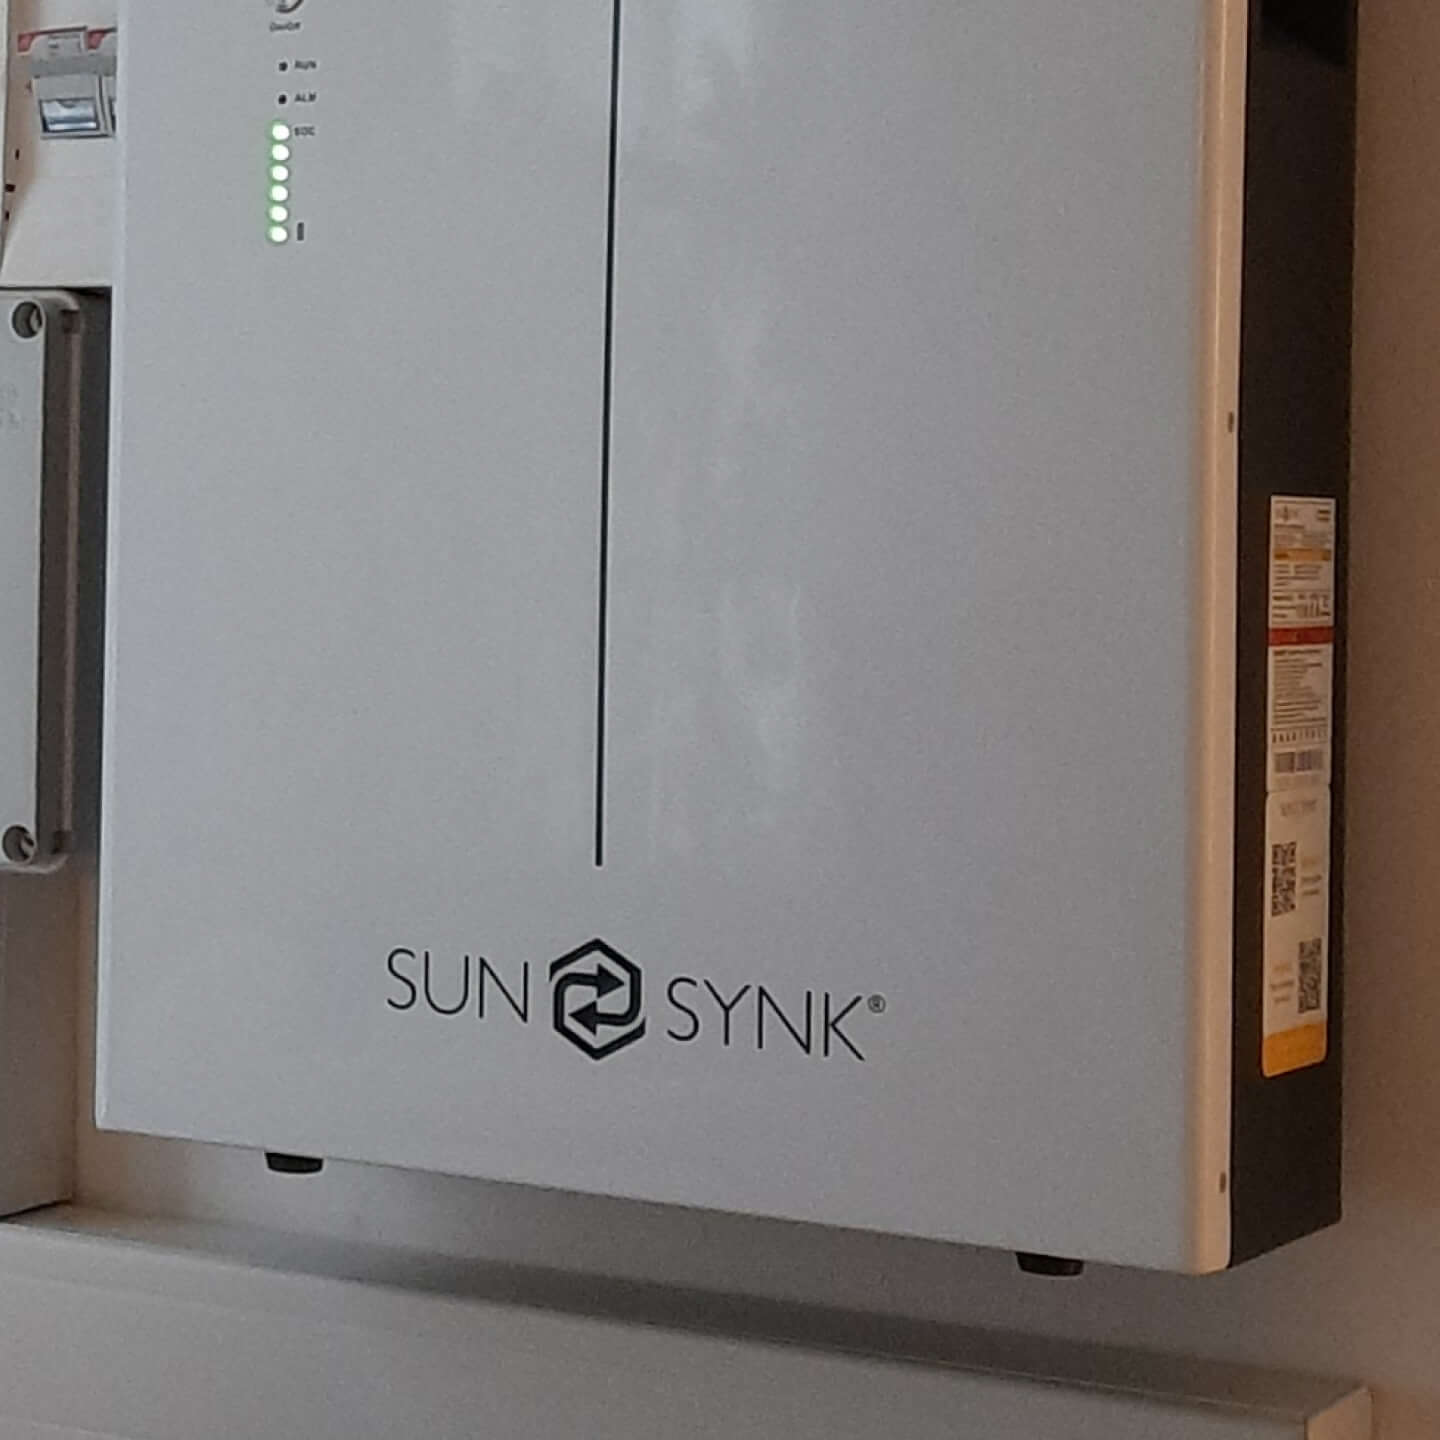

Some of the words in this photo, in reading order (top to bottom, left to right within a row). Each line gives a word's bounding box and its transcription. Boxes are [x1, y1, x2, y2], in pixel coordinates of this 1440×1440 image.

[295, 60, 317, 70] RUN
[294, 93, 317, 102] ALM
[295, 126, 315, 136] SOC
[387, 947, 528, 1023] SUN
